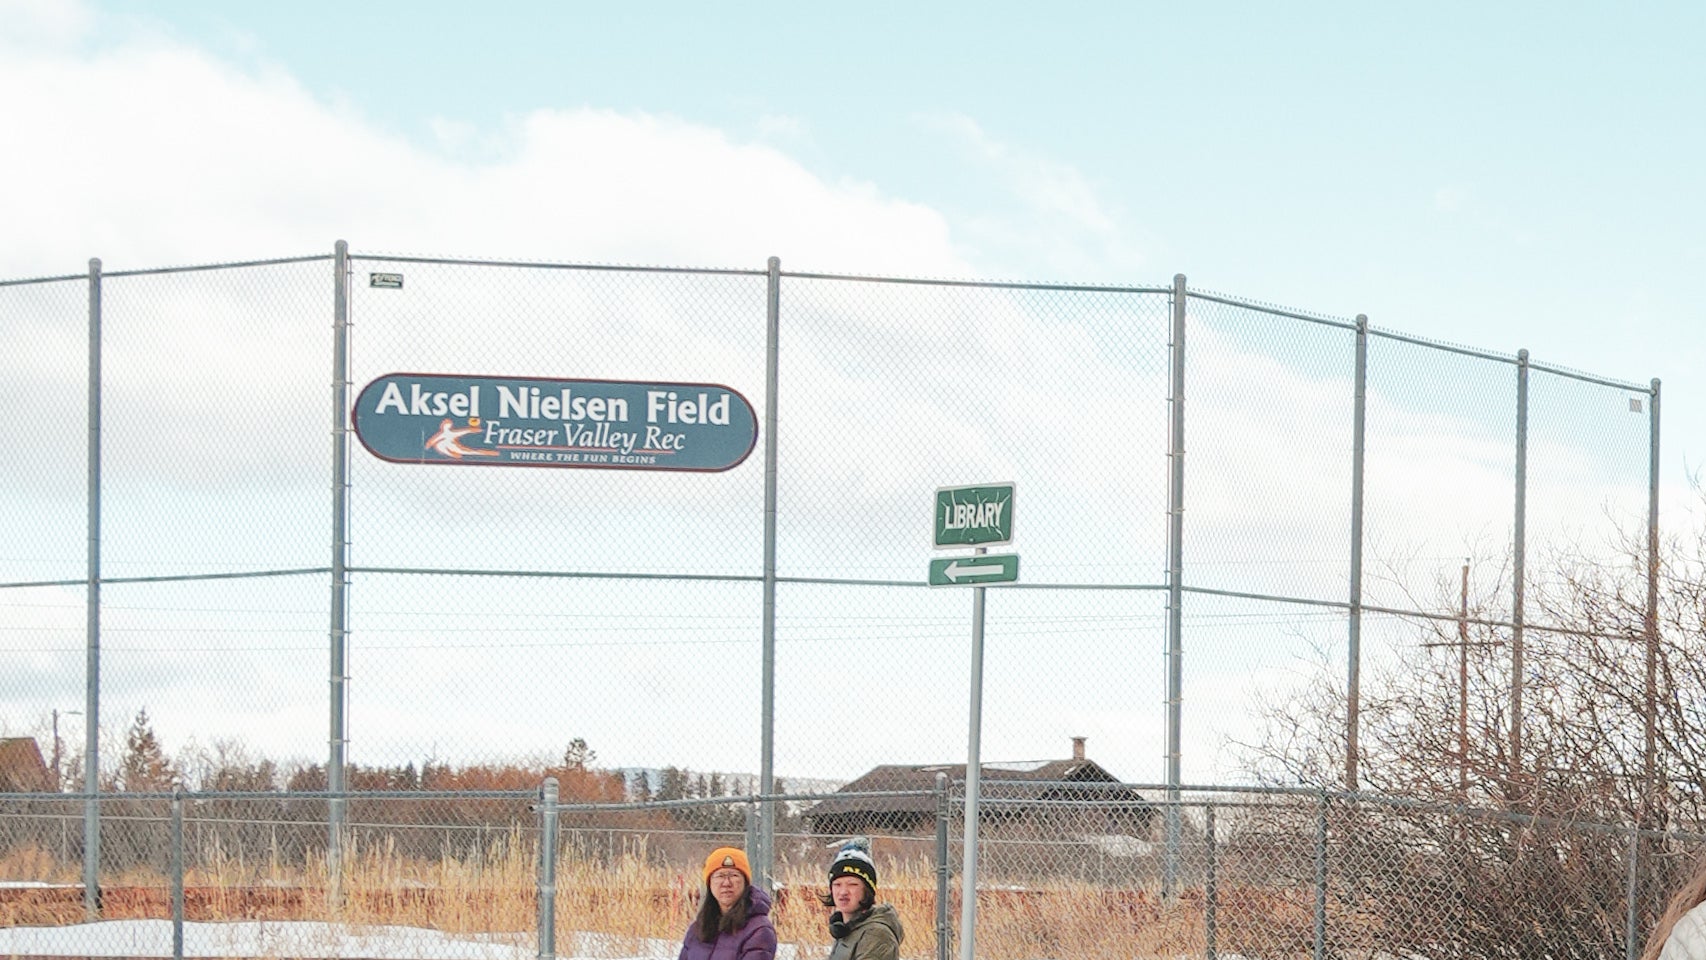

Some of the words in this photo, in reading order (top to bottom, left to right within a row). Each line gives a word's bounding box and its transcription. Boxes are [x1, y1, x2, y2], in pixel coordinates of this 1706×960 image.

[375, 382, 479, 417] Aksel
[496, 386, 628, 422] Nielsen
[648, 391, 730, 425] Field
[484, 420, 558, 446] Fraser
[563, 422, 637, 455] Valley
[643, 425, 686, 450] Rec
[510, 451, 553, 461] WHERE
[556, 453, 579, 462] THE
[583, 454, 608, 463] FUN
[612, 455, 656, 464] BEGINS
[944, 502, 1004, 530] LIBRARY
